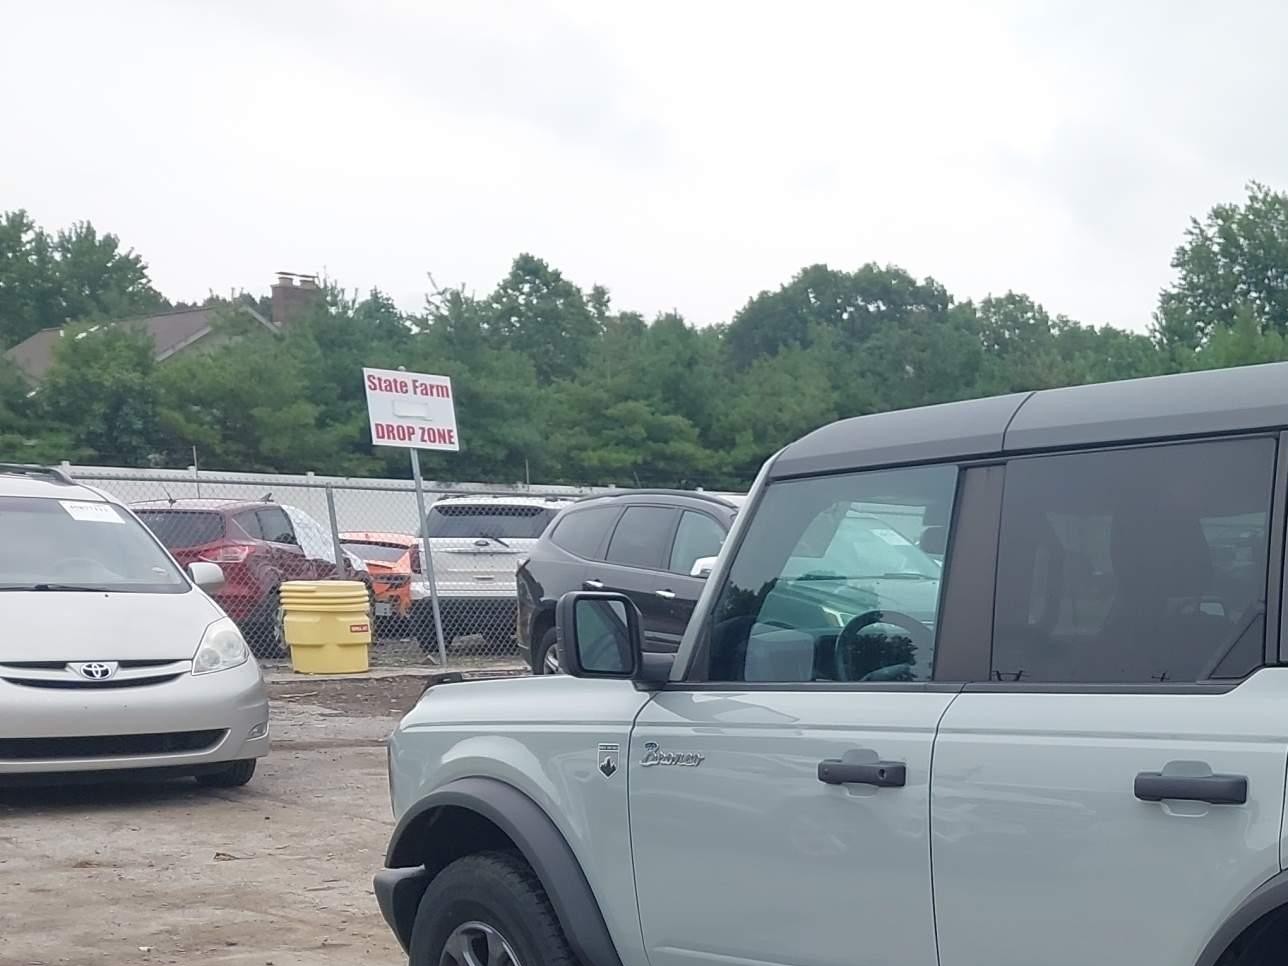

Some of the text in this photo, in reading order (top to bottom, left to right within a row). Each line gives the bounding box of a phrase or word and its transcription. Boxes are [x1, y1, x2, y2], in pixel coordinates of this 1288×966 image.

[367, 374, 450, 399] State Farm
[375, 423, 455, 445] DROP ZONE
[639, 742, 705, 768] Bronco
